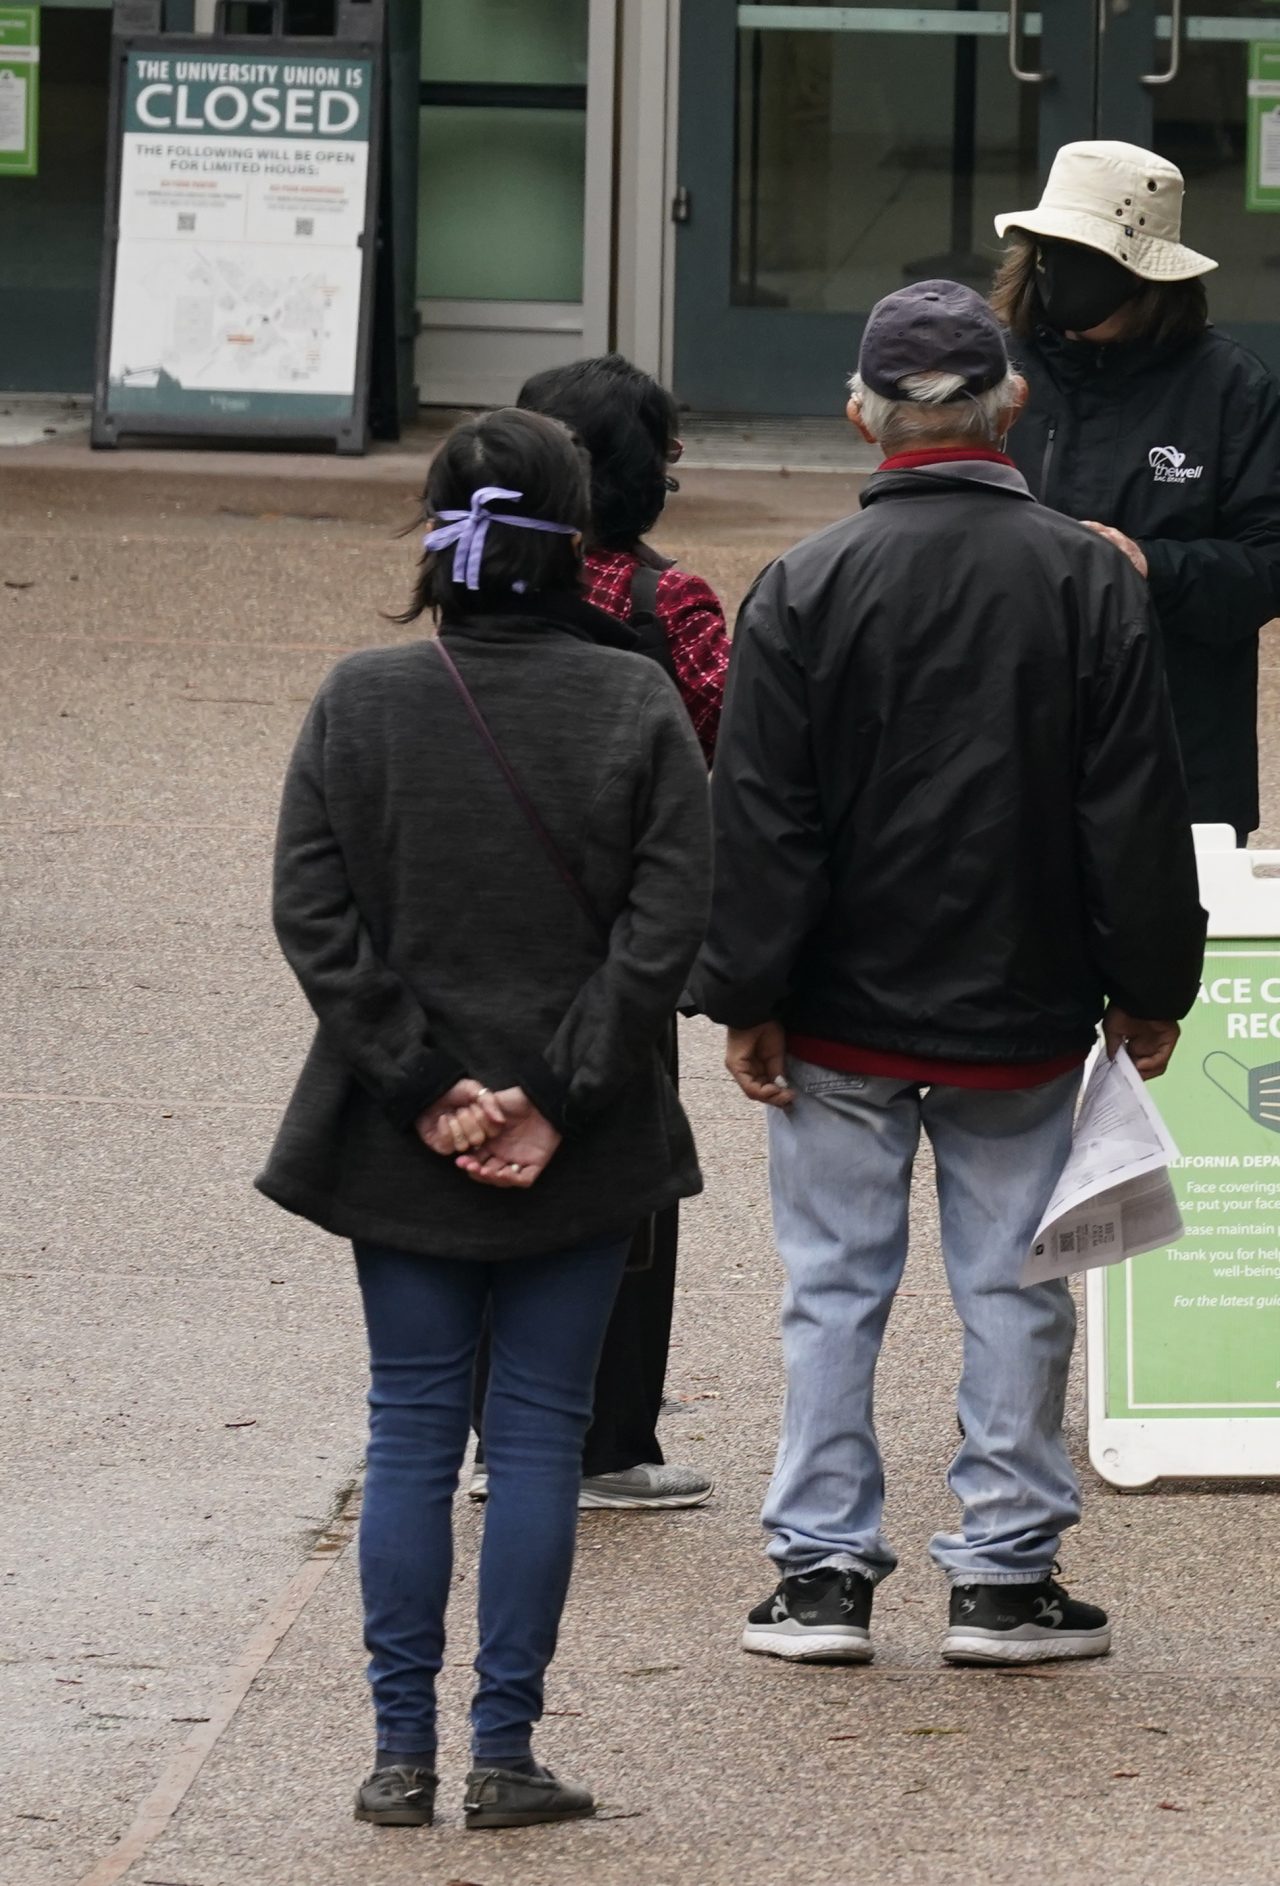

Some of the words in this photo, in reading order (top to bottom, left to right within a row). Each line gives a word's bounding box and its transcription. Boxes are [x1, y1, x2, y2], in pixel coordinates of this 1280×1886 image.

[137, 60, 169, 79] THE
[176, 62, 278, 83] UNIVERSITY
[283, 65, 339, 85] UNION
[346, 68, 363, 88] IS
[136, 84, 359, 134] CLOSED
[136, 144, 163, 156] THE
[167, 145, 253, 159] FOLLOWING
[257, 148, 289, 160] WILL
[294, 150, 311, 161] BE
[315, 151, 355, 162] OPEN
[170, 159, 198, 171] FOR
[203, 160, 260, 173] LIMITED
[1198, 978, 1251, 1003] ACE
[1187, 1182, 1216, 1193] Face
[1197, 1200, 1219, 1213] put
[1223, 1201, 1251, 1213] your
[1185, 1226, 1213, 1235] ease
[1217, 1223, 1274, 1235] maintain
[1167, 1249, 1206, 1261] Thank
[1210, 1252, 1234, 1263] you
[1237, 1248, 1255, 1260] for
[1174, 1295, 1194, 1307] For
[1197, 1294, 1217, 1306] the
[1220, 1294, 1254, 1306] latest
